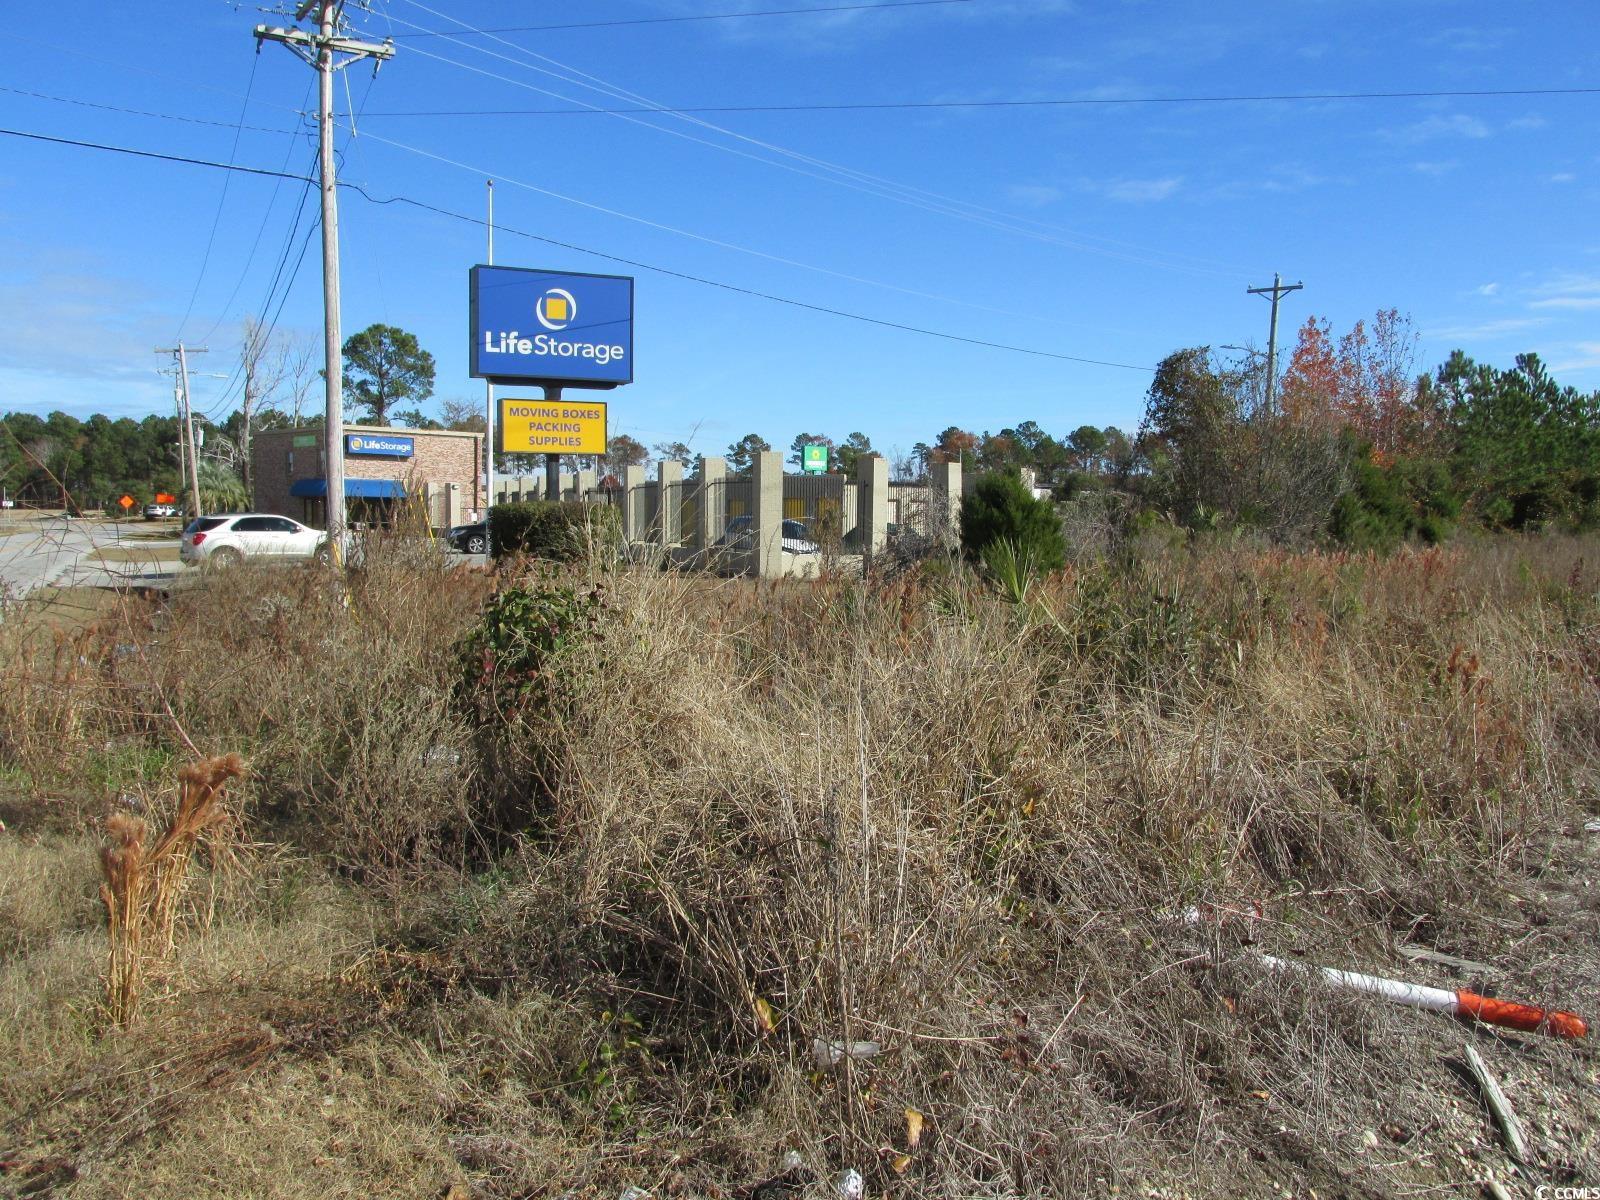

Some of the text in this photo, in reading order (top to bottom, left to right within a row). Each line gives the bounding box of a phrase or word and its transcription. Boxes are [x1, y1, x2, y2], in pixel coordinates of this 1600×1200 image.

[509, 407, 600, 419] MOVING BOXES
[529, 422, 581, 433] PACKING
[529, 436, 582, 446] SUPPLIES
